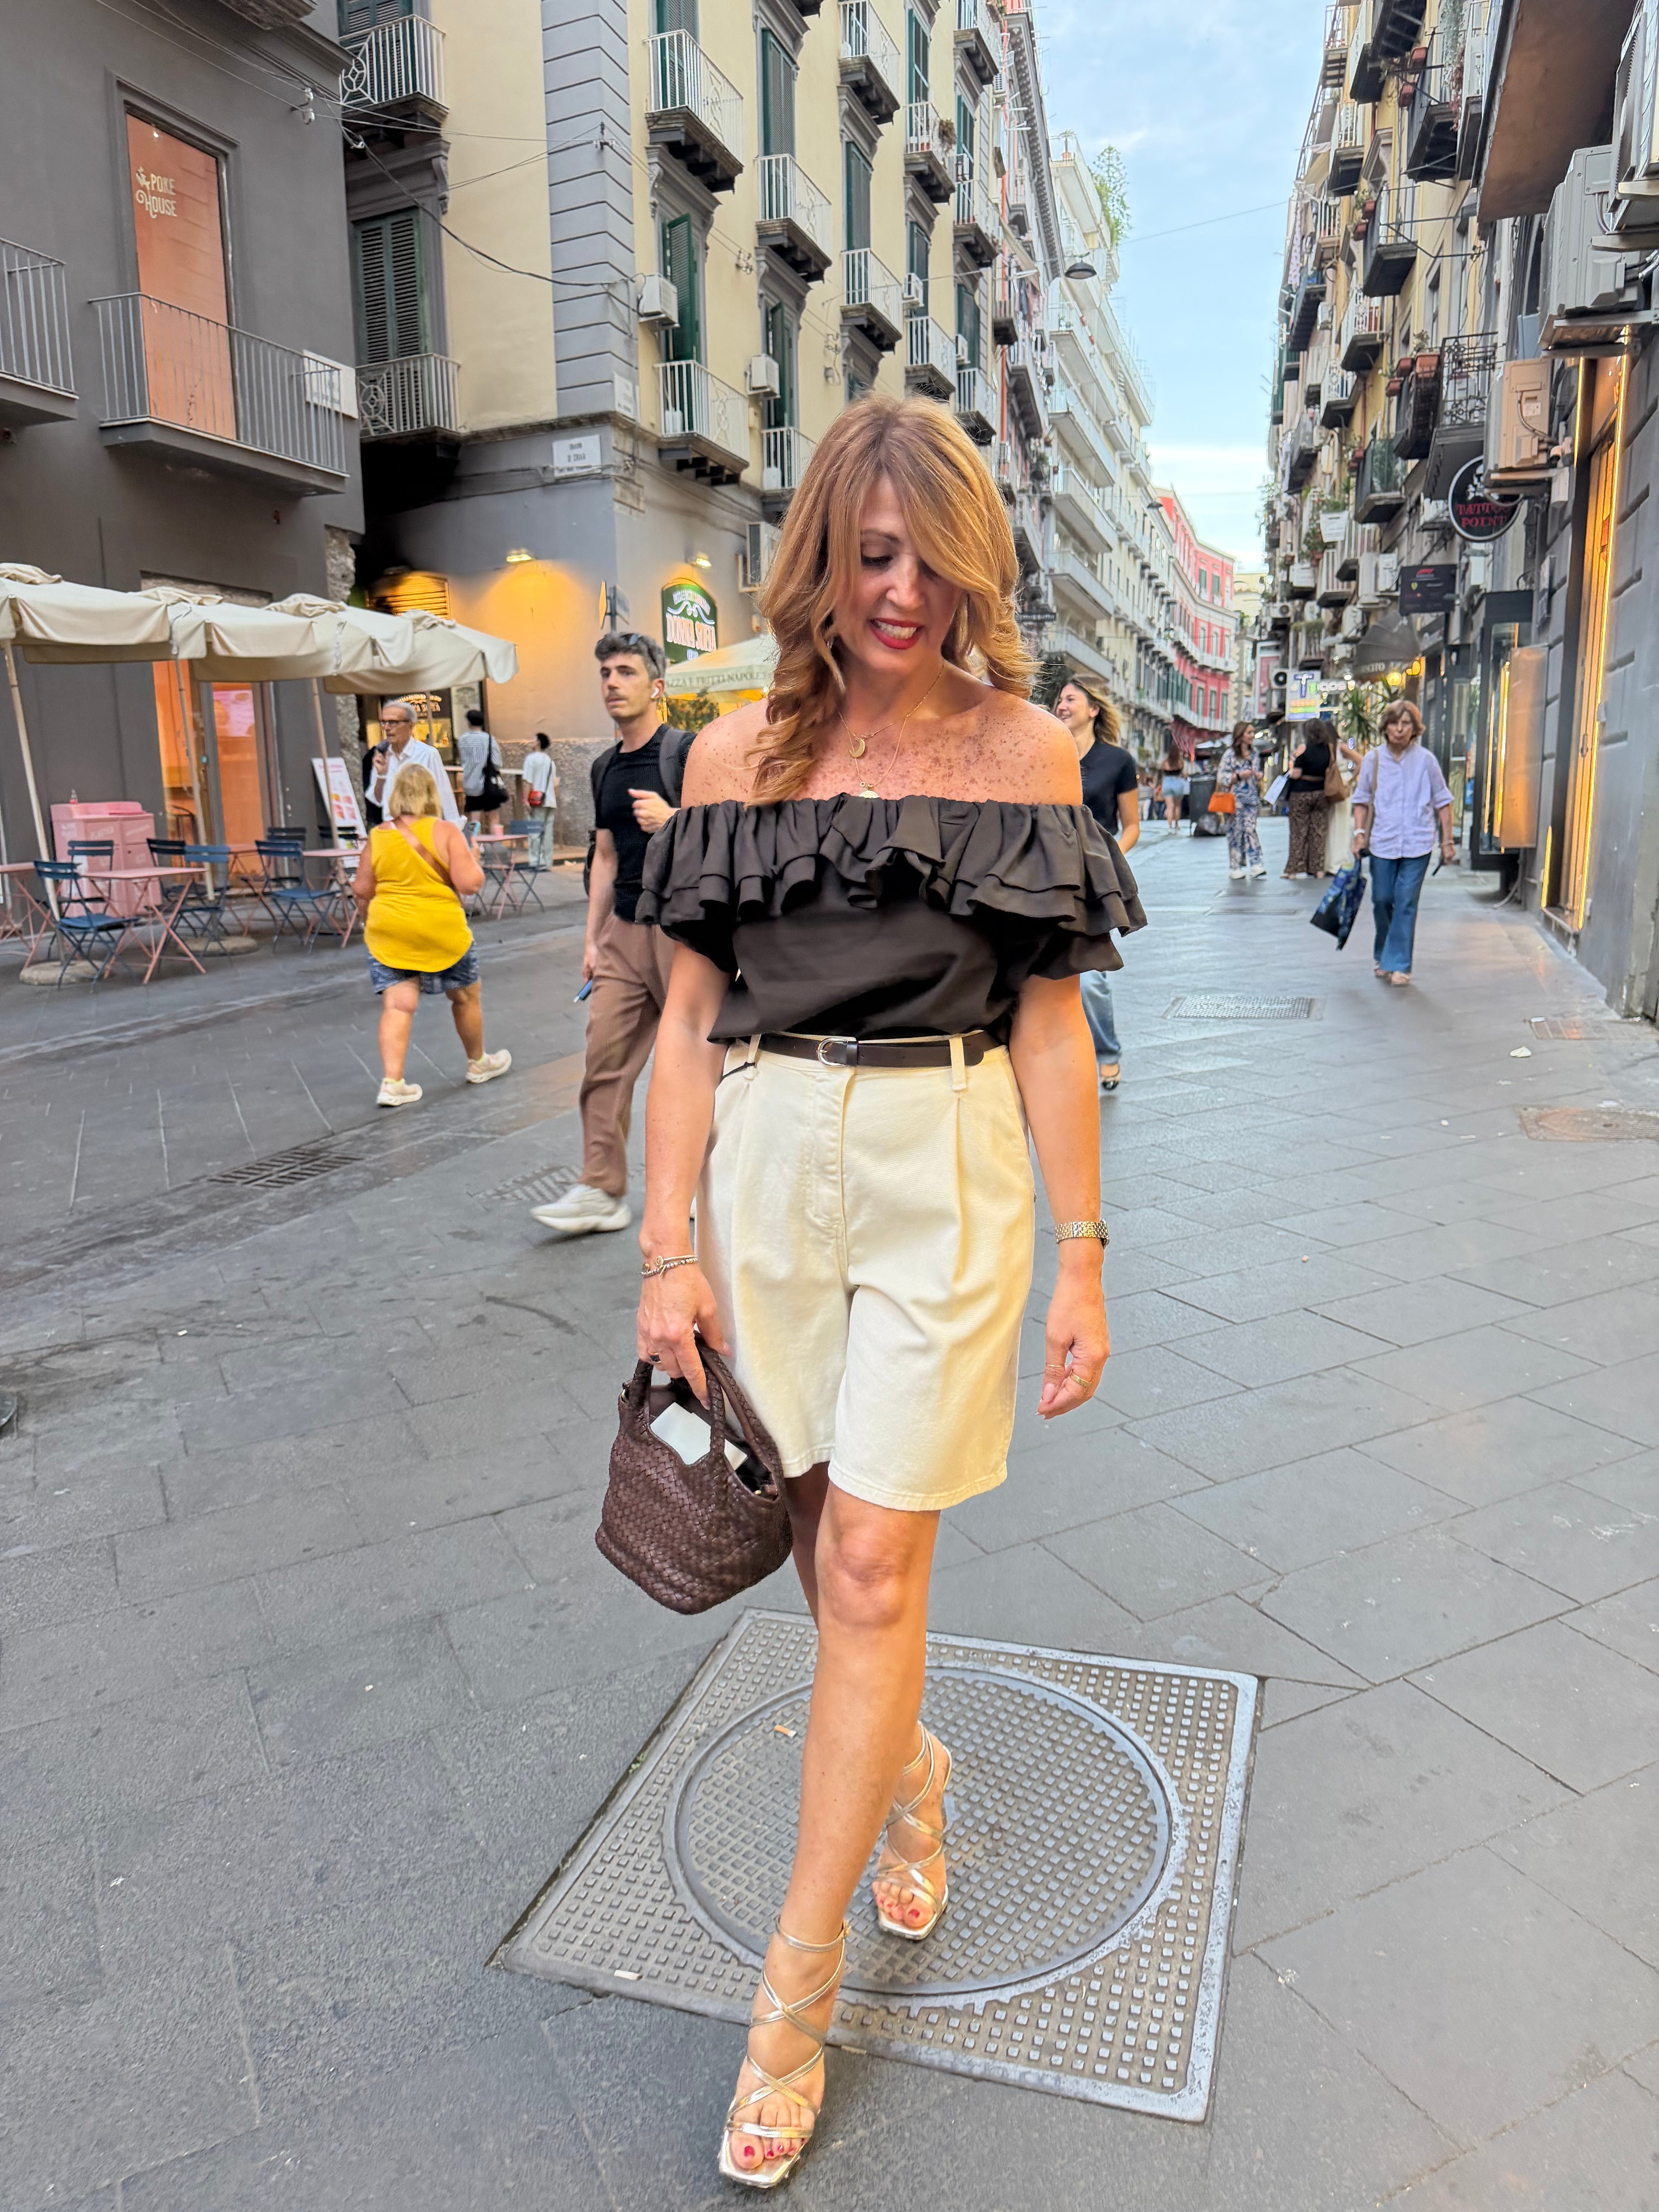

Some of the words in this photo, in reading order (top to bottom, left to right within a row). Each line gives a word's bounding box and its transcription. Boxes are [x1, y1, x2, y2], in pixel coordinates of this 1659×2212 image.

[150, 173, 176, 196] POKE
[136, 189, 177, 219] HOUSE
[1461, 515, 1507, 529] POINT
